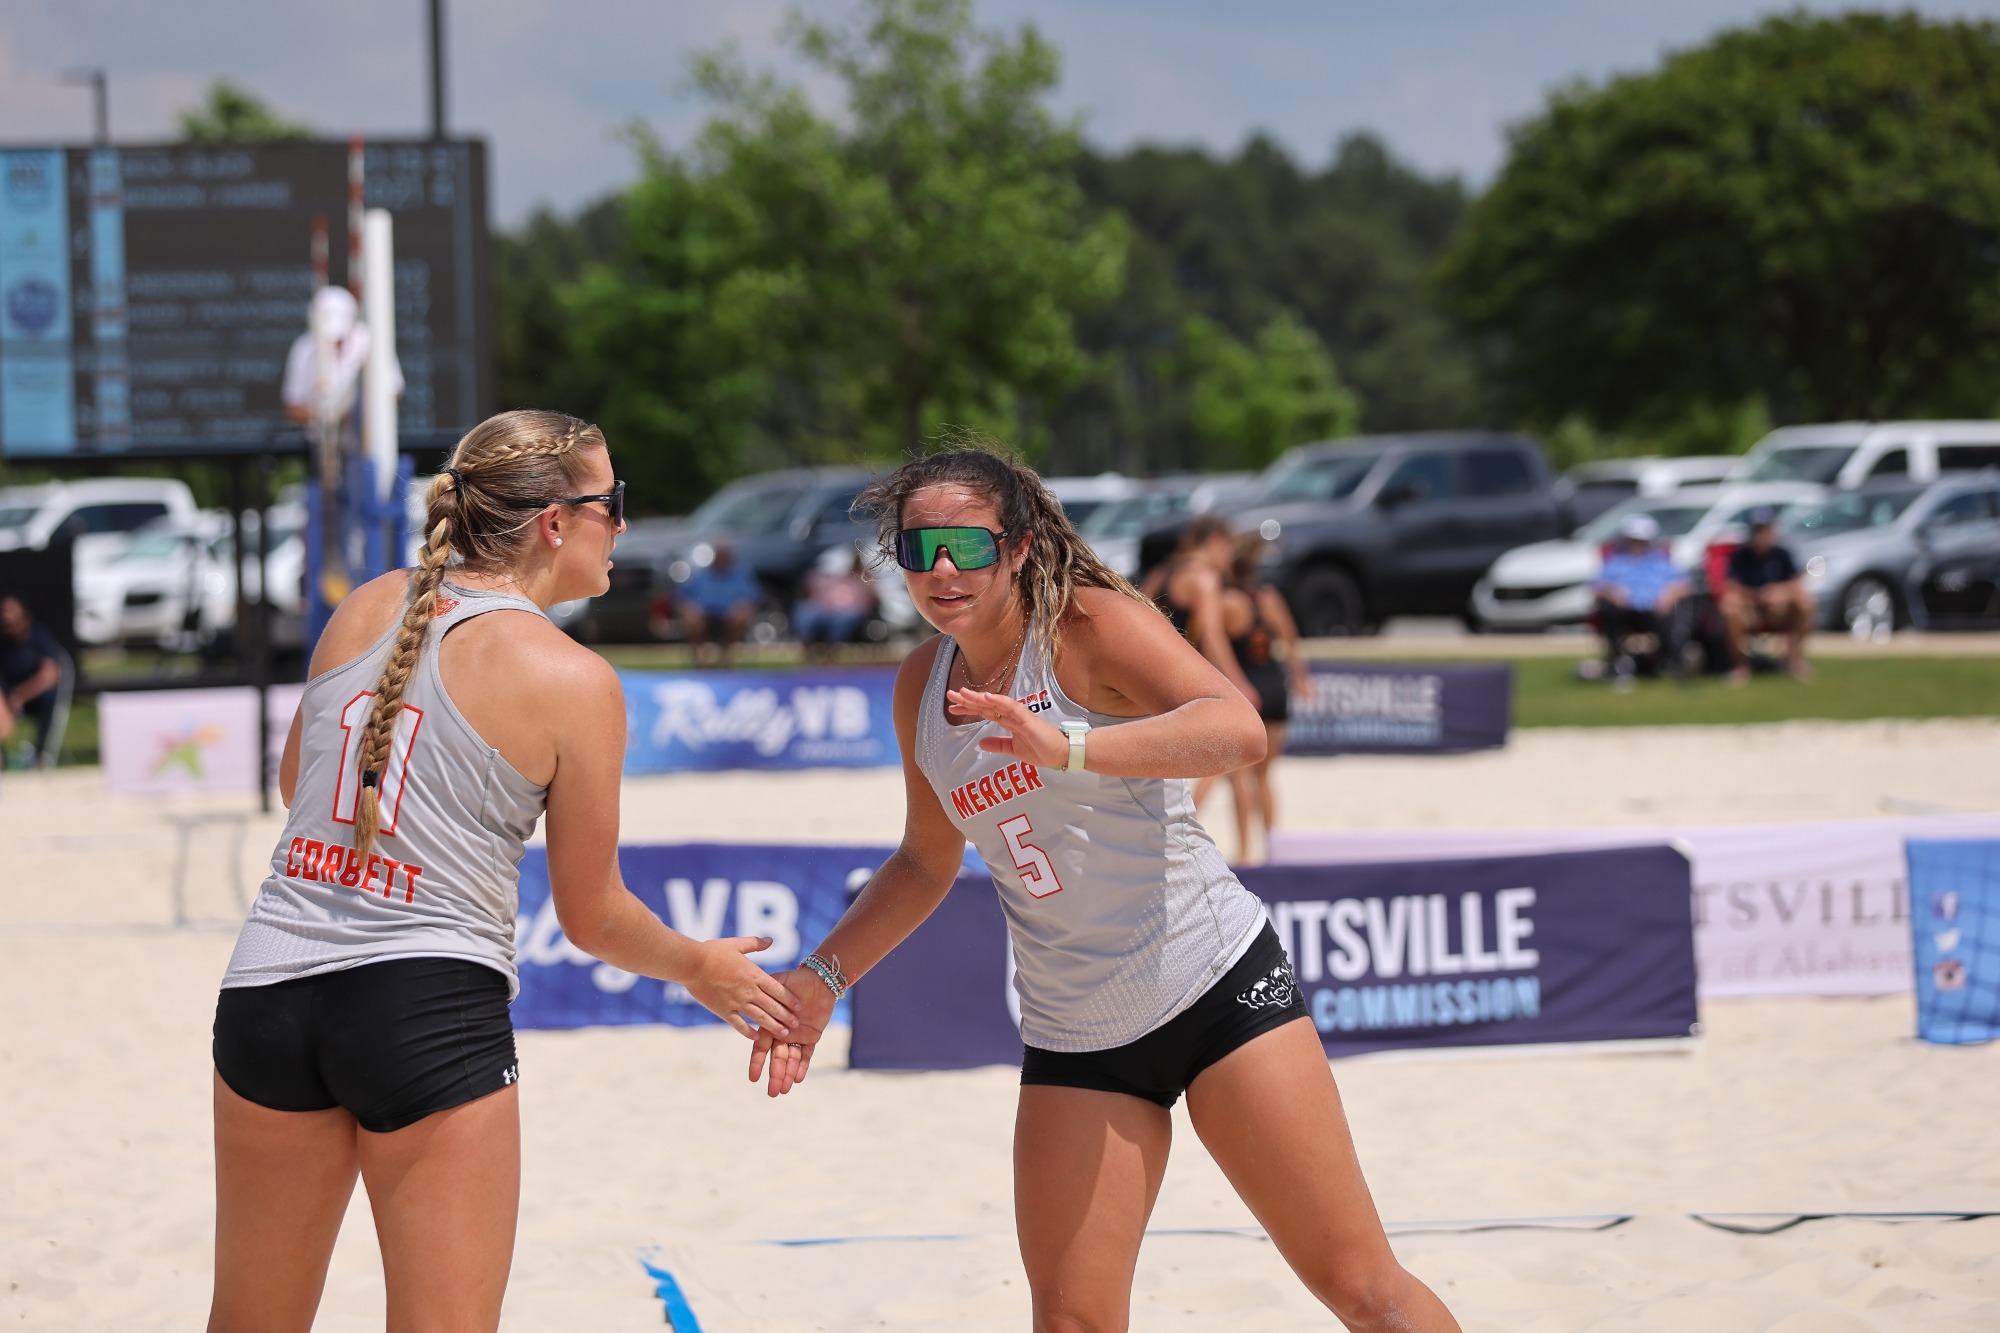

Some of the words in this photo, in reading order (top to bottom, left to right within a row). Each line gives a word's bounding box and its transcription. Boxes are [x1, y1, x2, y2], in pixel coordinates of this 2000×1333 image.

[950, 760, 1044, 821] MERCER
[286, 836, 424, 904] CORBETT
[996, 813, 1063, 899] 5
[1313, 975, 1541, 1033] COMMISSION
